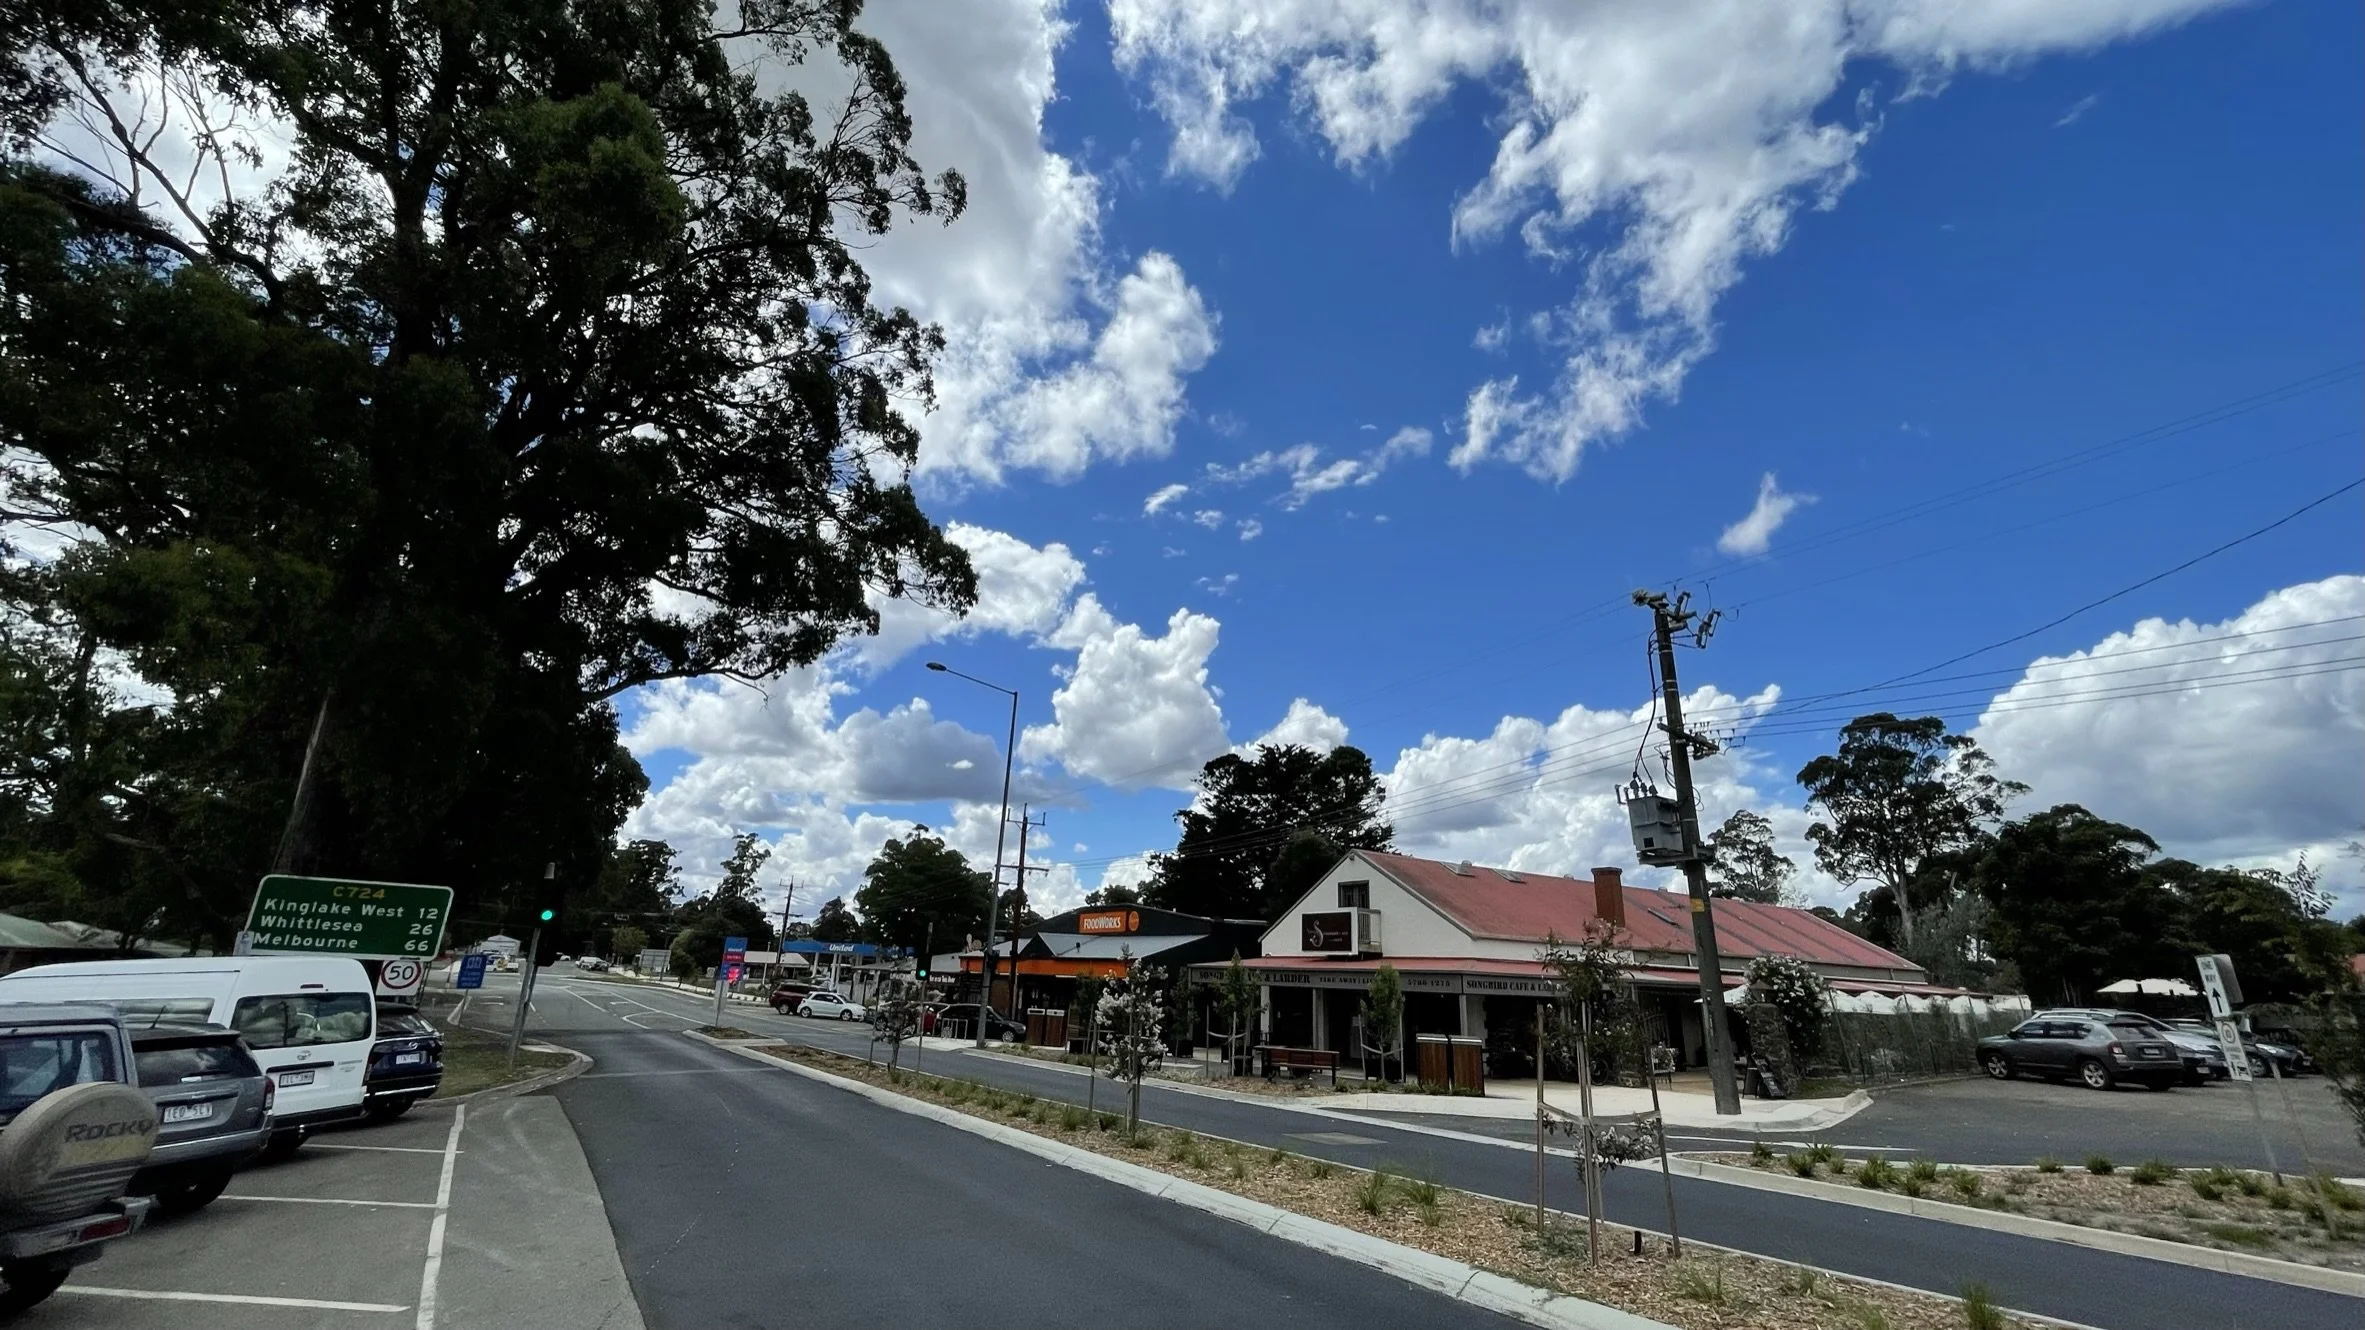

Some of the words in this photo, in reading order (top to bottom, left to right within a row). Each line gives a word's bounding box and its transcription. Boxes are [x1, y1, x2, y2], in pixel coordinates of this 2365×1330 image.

[333, 886, 385, 899] C724
[264, 898, 351, 915] Kinglake
[361, 903, 405, 917] West
[419, 907, 439, 920] 12
[260, 914, 363, 932] Whittlesea
[409, 923, 433, 936] 26
[253, 932, 358, 949] Melbourne
[404, 939, 429, 951] 66
[828, 943, 854, 952] United
[388, 965, 414, 981] 50
[1273, 973, 1311, 984] LARDER
[1466, 980, 1508, 990] SONGBIRD
[1509, 981, 1529, 991] CAFE
